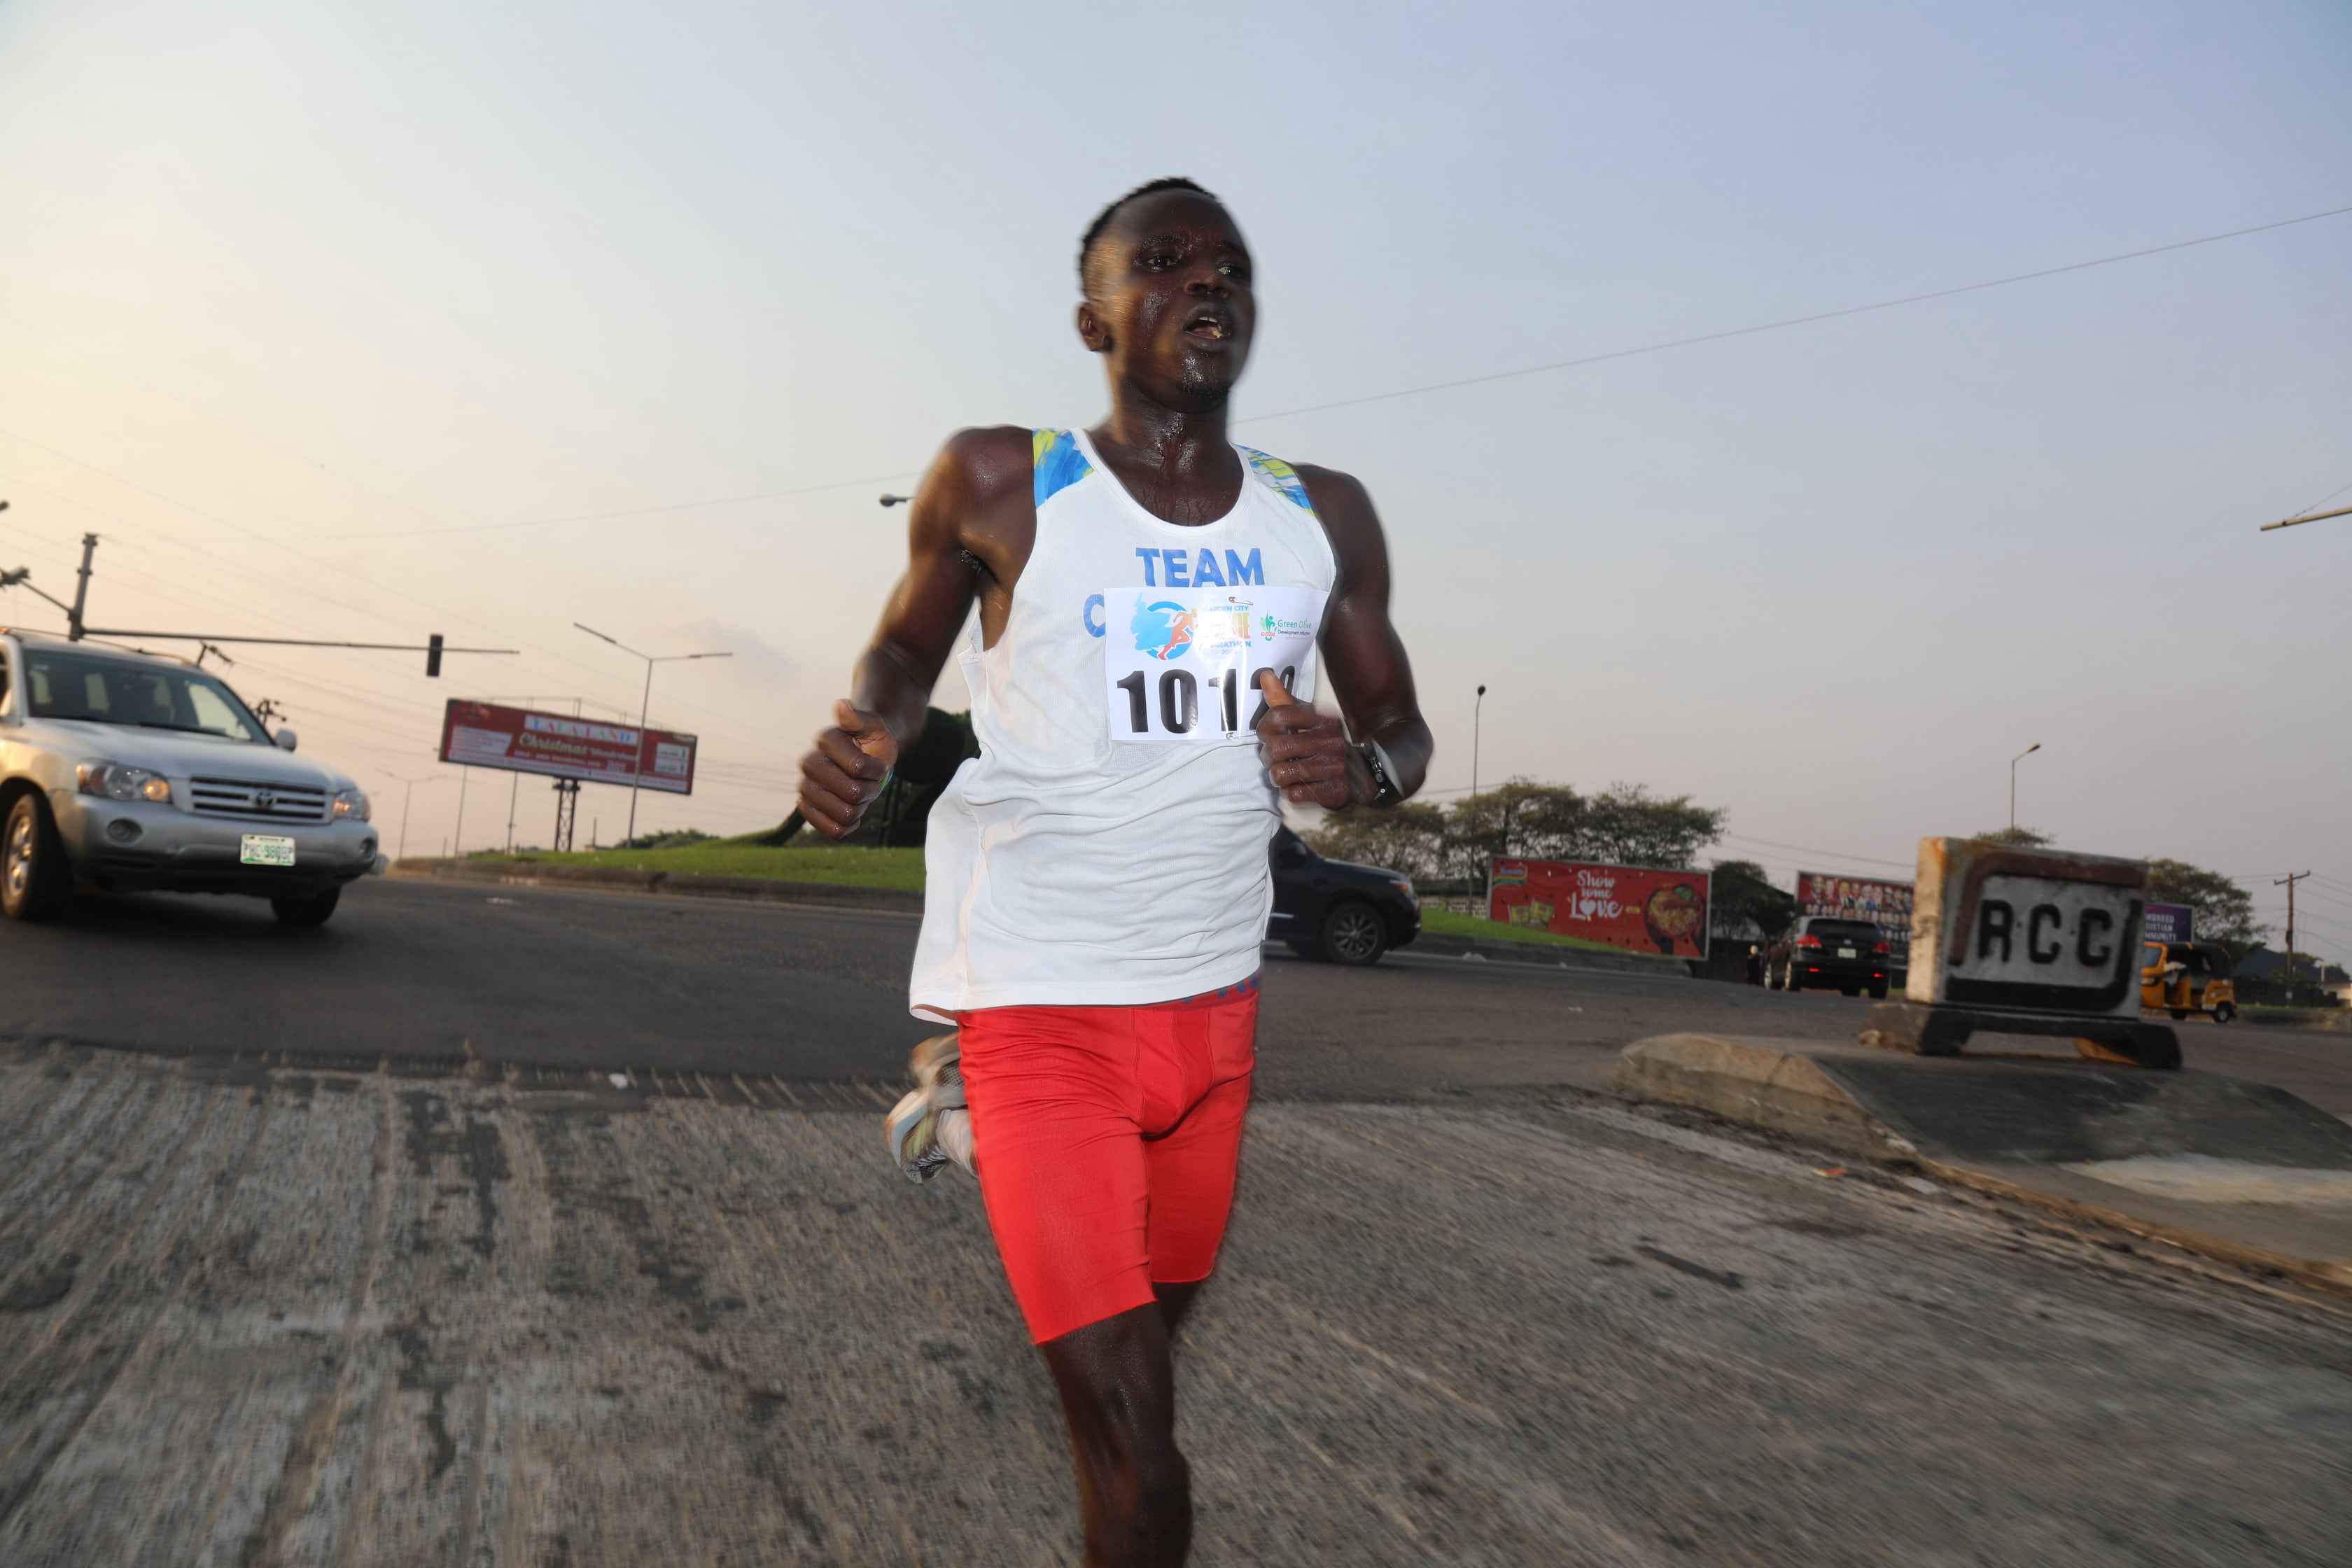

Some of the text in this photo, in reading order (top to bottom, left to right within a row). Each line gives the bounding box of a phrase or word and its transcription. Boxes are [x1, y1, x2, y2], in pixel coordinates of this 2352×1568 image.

[1135, 547, 1265, 587] TEAM
[1278, 618, 1312, 629] Green Olive
[1576, 869, 1616, 888] Show
